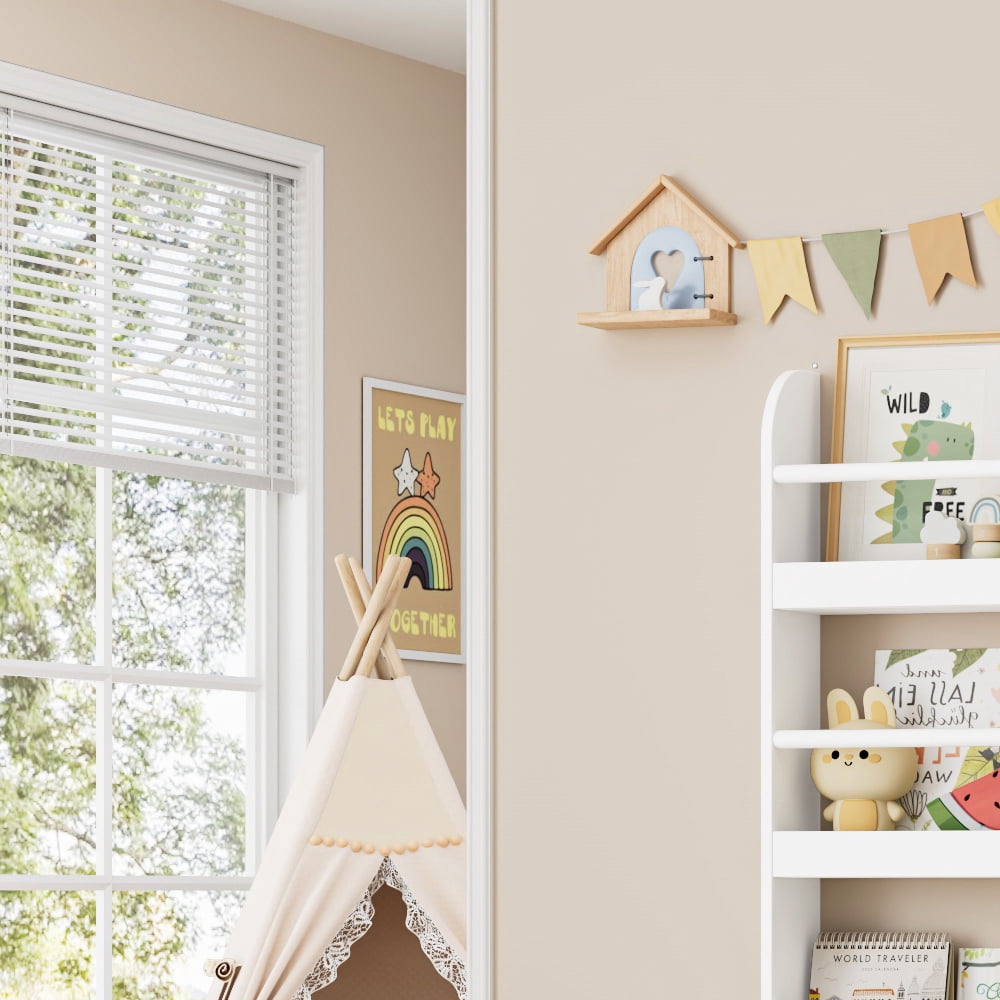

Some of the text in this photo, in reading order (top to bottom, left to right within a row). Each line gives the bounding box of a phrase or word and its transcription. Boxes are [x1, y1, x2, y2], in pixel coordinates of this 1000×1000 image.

[887, 391, 930, 414] WILD
[378, 405, 457, 441] LETS PLAY
[388, 608, 458, 639] OGETHER
[833, 954, 930, 963] WORLD TRAVELER
